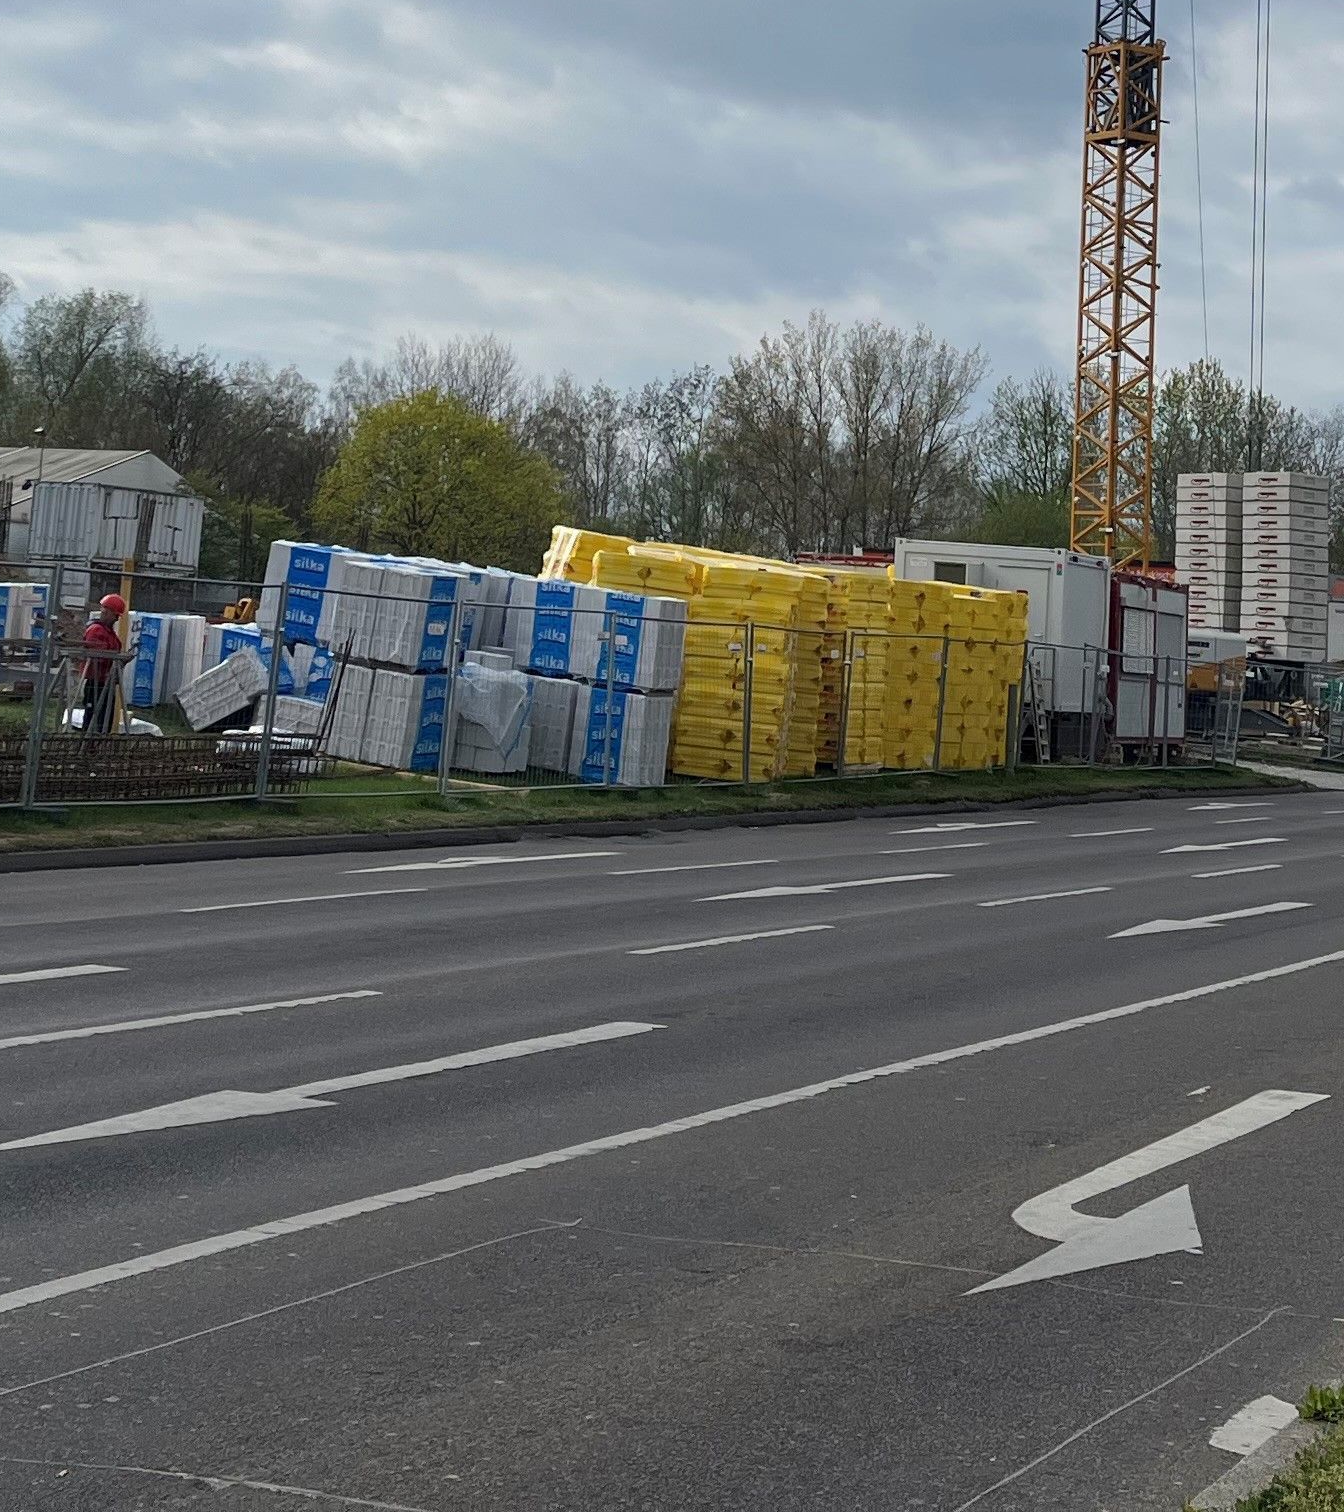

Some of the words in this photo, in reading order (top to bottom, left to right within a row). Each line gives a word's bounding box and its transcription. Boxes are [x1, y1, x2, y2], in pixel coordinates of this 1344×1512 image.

[293, 557, 325, 573] silka
[285, 608, 315, 625] silka
[537, 628, 567, 643] silka
[534, 654, 565, 669] silka
